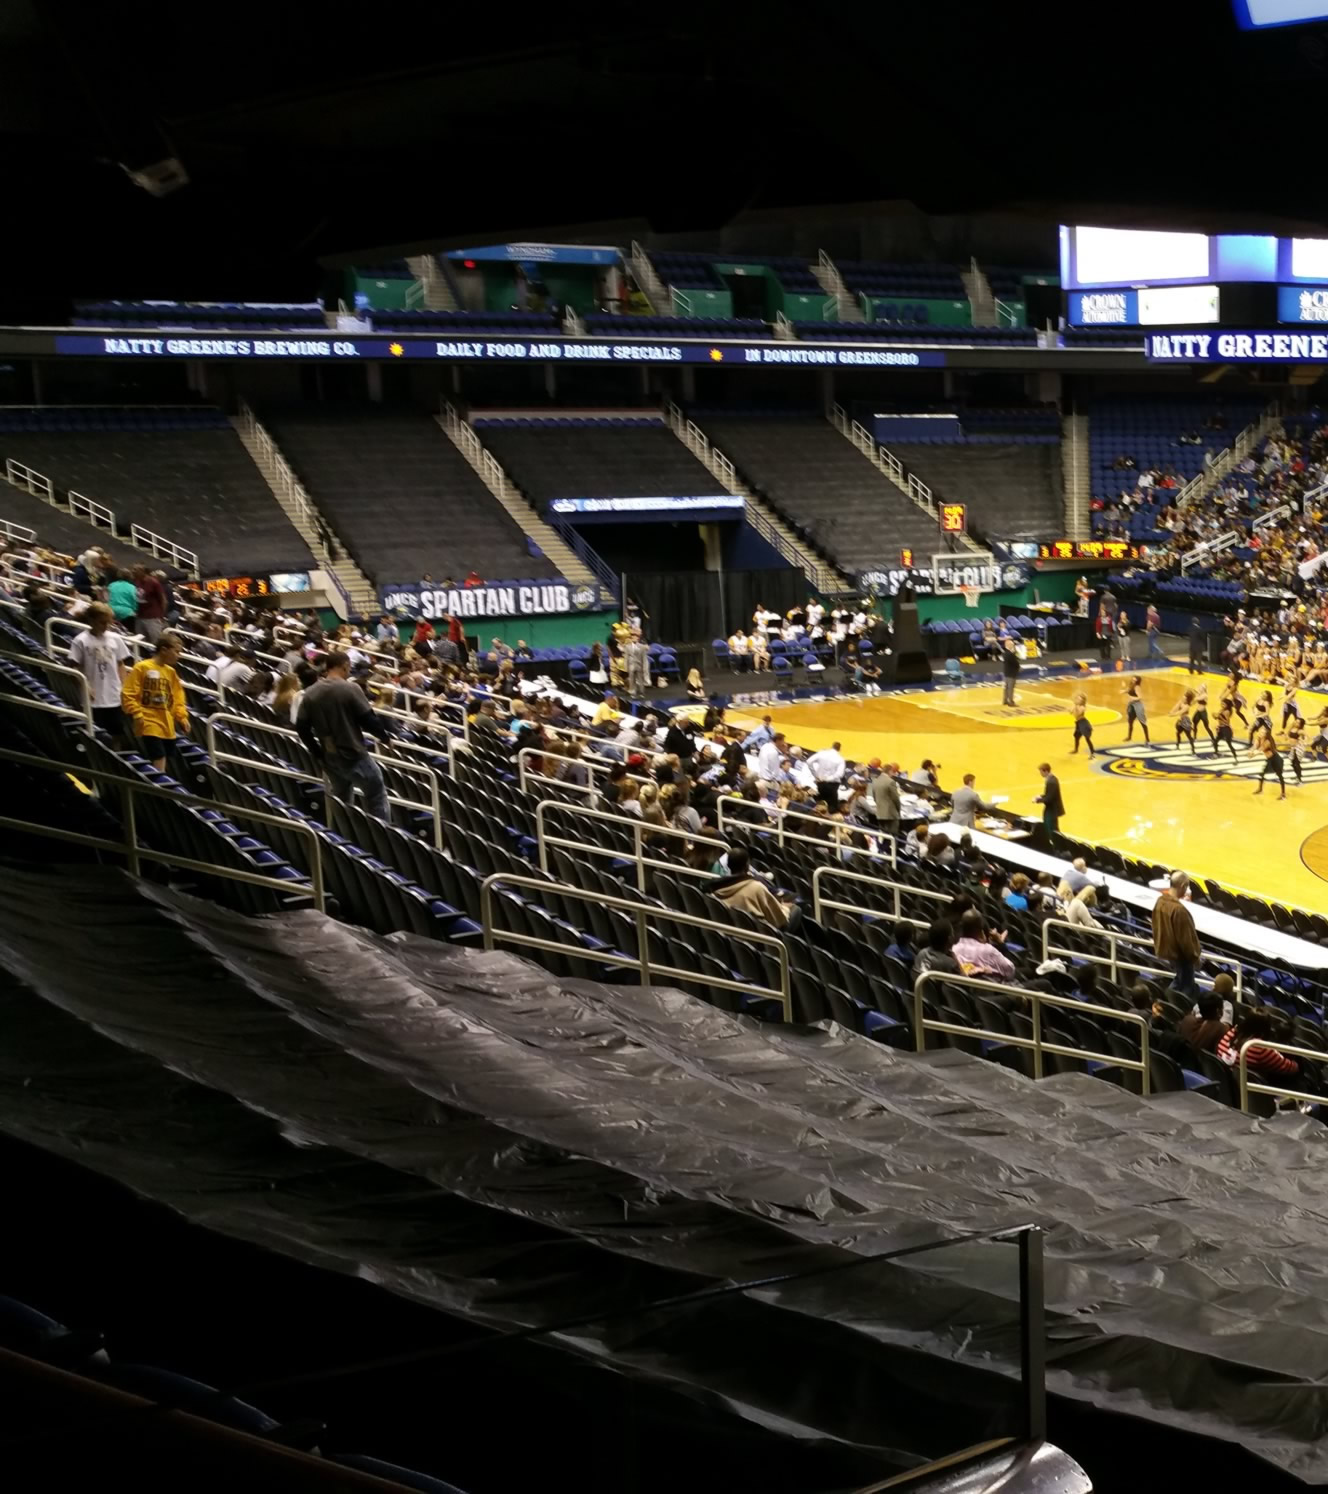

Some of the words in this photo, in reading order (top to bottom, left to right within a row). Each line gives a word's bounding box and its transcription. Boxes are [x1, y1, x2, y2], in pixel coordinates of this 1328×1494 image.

[104, 338, 165, 354] NATTY
[166, 339, 250, 355] GREENE'S
[252, 340, 330, 356] BREWING
[332, 342, 360, 356] CO.
[436, 342, 483, 357] DAILY
[486, 343, 527, 357] FOOD
[528, 344, 561, 358] AND
[563, 344, 612, 359] DRINK
[613, 345, 682, 360] SPECIALS
[1152, 336, 1210, 357] NATTY
[744, 349, 761, 362] IN
[763, 349, 837, 363] DOWNTOWN
[838, 351, 919, 365] GREENSBORO
[420, 588, 515, 618] SPARTAN
[519, 585, 569, 613] CLUB
